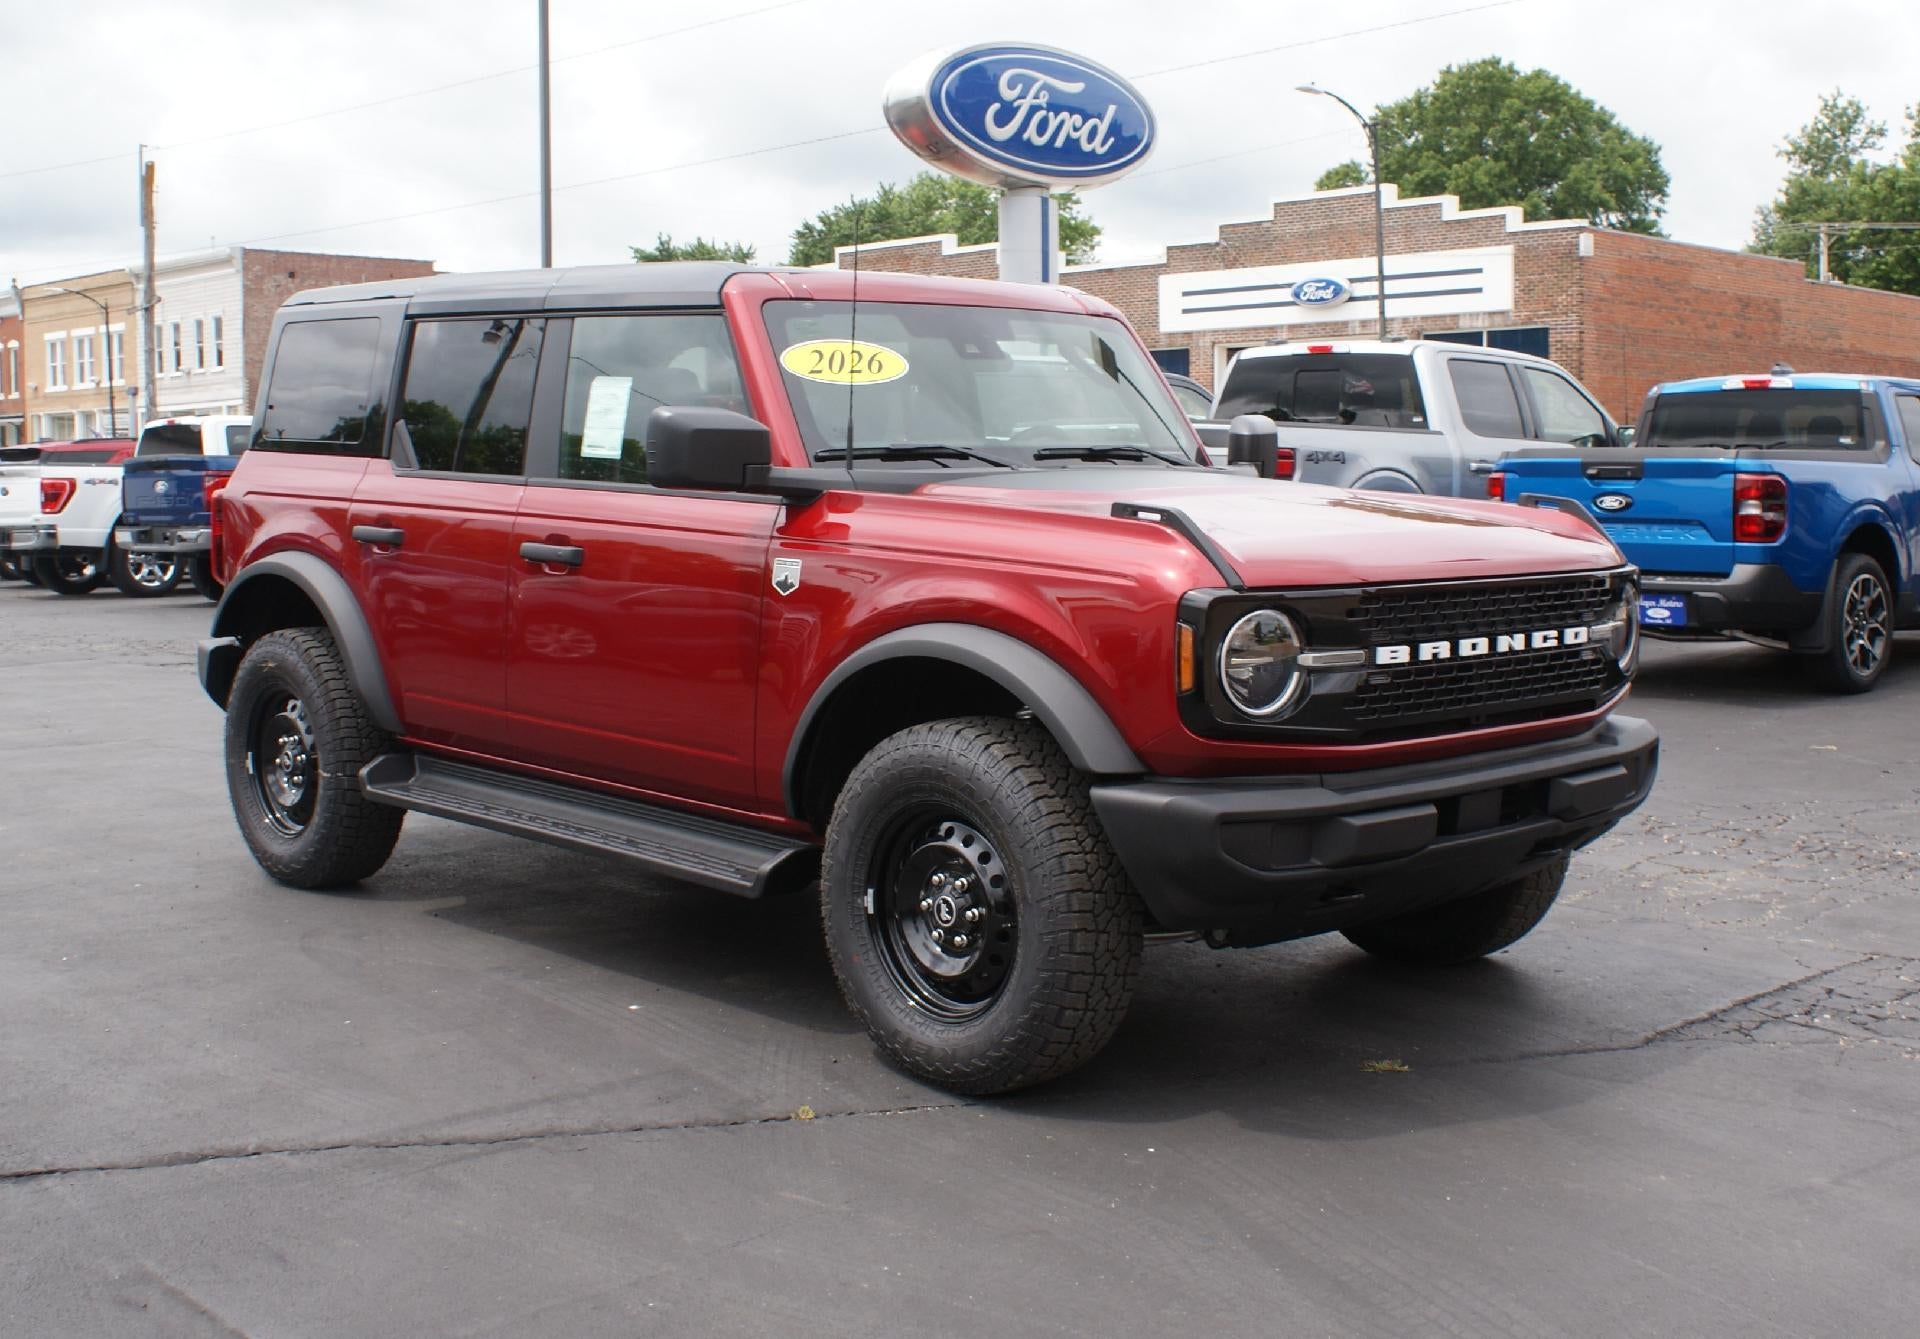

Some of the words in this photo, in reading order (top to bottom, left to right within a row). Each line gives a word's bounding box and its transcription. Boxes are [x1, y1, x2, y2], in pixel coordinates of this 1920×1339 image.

[984, 67, 1117, 155] Ford
[1299, 281, 1336, 301] Ford
[808, 349, 884, 375] 2026
[1375, 626, 1588, 665] BRONCO
